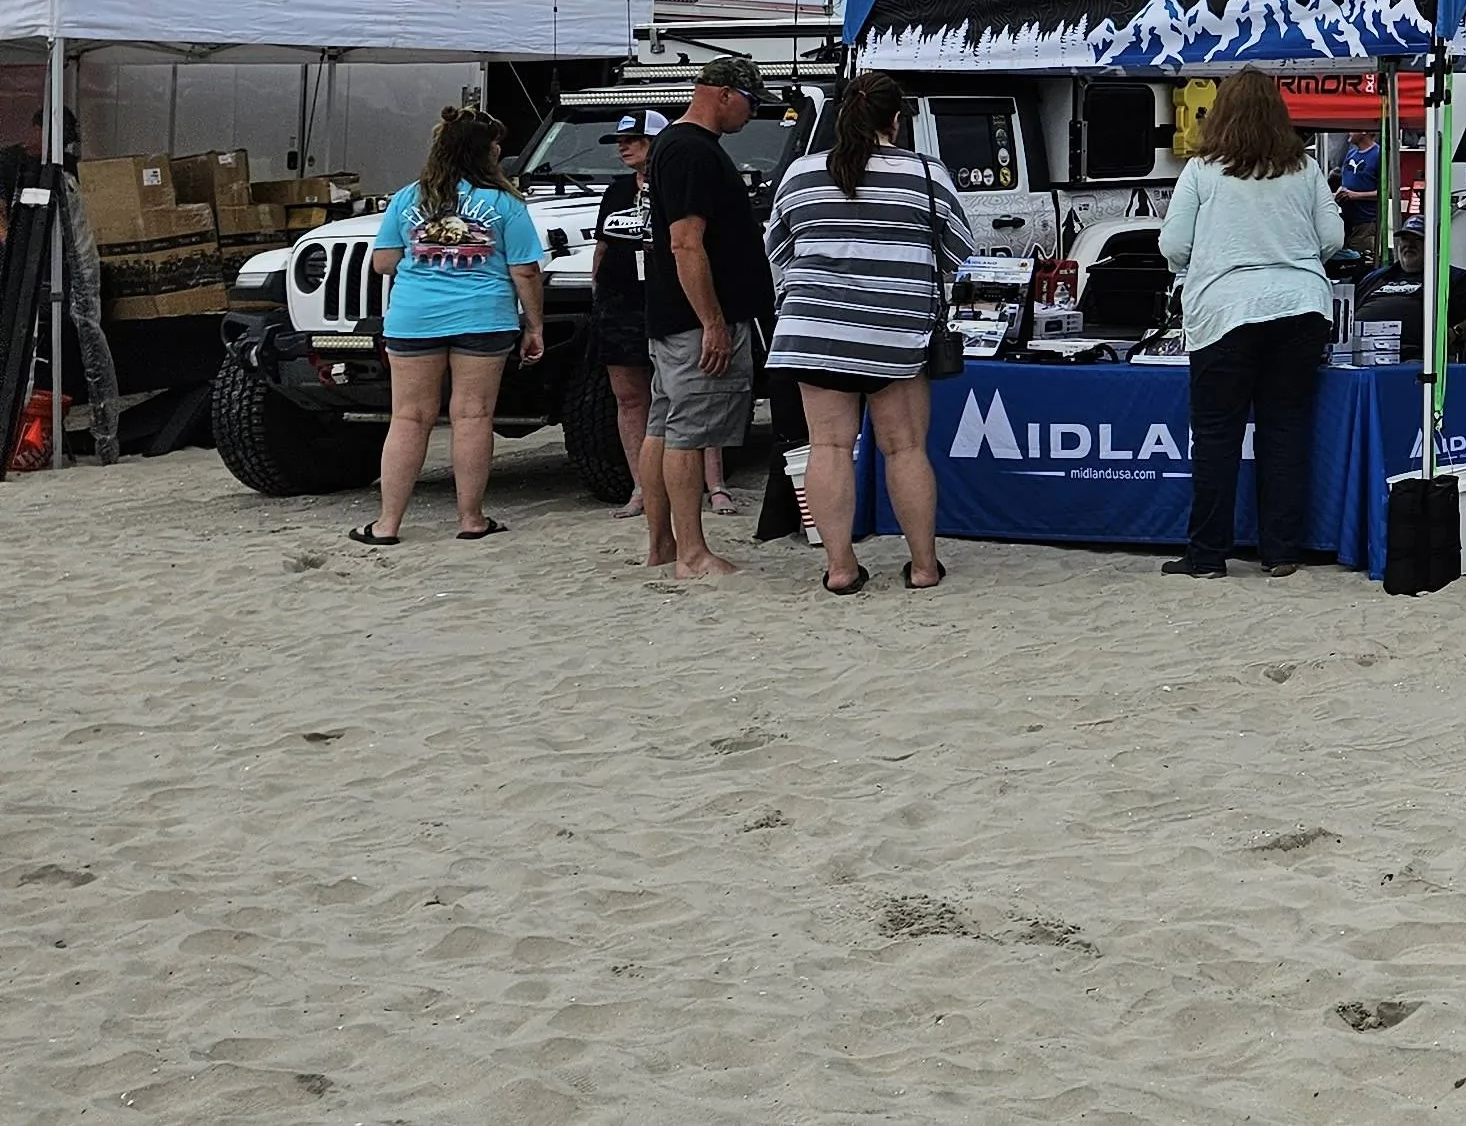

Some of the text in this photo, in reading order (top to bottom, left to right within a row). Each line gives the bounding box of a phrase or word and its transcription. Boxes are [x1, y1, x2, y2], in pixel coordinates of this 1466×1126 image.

[456, 192, 502, 227] TRAIL
[950, 388, 1255, 460] MIDLA
[1070, 467, 1156, 481] midlandusa.com
